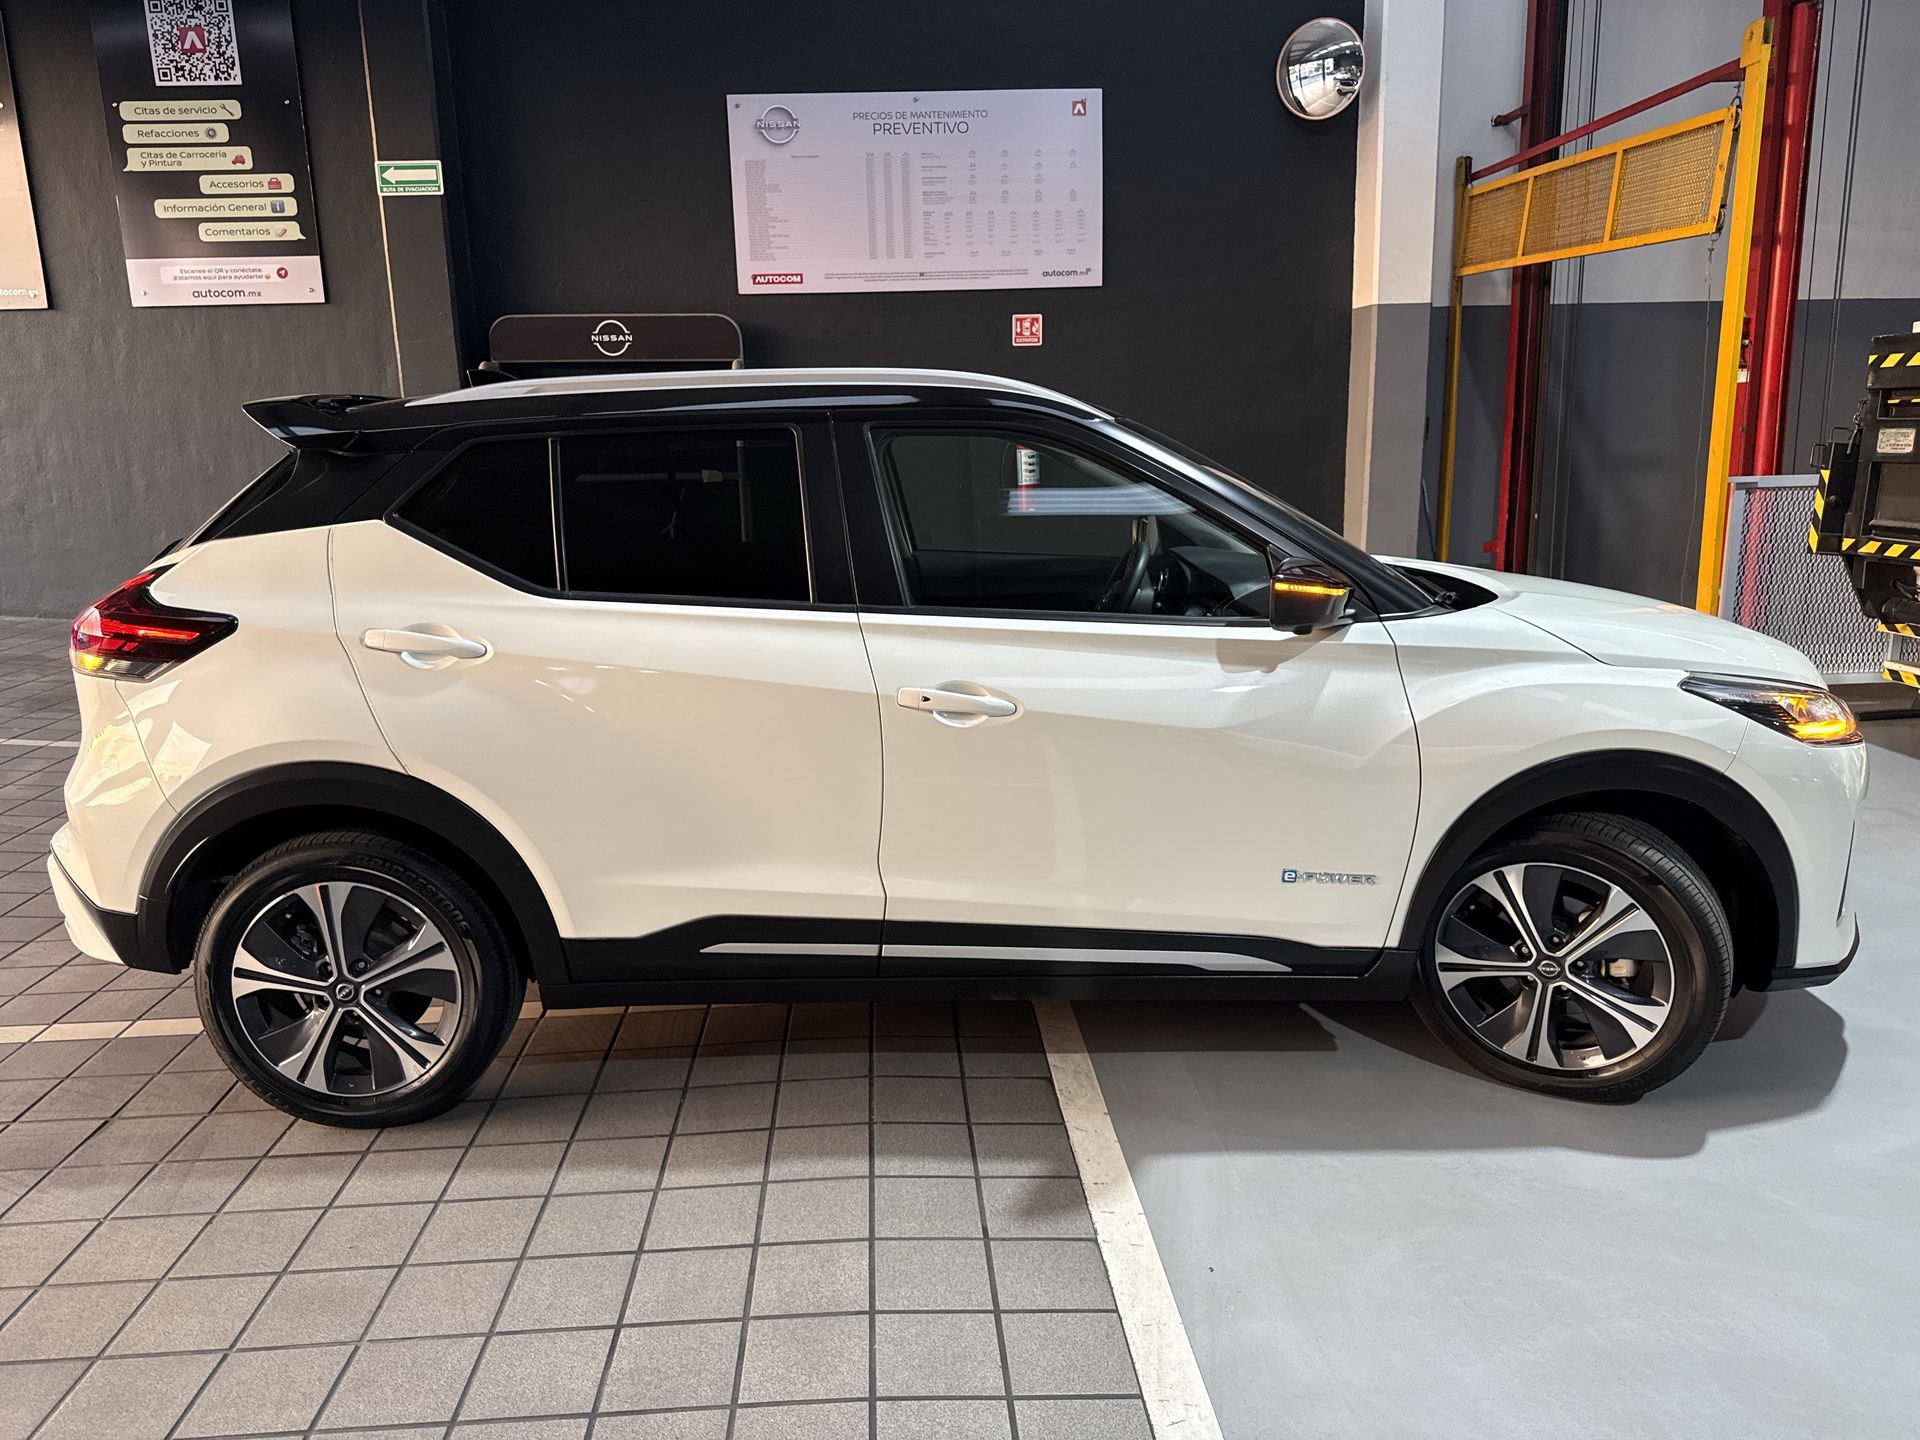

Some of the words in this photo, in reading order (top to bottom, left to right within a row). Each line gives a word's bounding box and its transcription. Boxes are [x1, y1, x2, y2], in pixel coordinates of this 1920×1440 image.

[134, 106, 161, 116] Citas
[162, 106, 176, 115] de
[178, 105, 218, 115] servicio
[853, 111, 893, 120] PRECIOS
[895, 111, 907, 120] DE
[909, 109, 989, 119] MANTENIMIENTO
[756, 120, 801, 128] NISSAN
[872, 121, 970, 135] PREVENTIVO
[137, 129, 200, 138] Refacciones
[140, 151, 164, 159] Citas
[166, 151, 178, 159] de
[140, 160, 147, 168] y
[149, 159, 182, 167] Pintura
[209, 180, 265, 189] Accesorios
[163, 203, 226, 213] Información
[228, 203, 267, 212] General
[204, 228, 271, 237] Comentarios
[755, 275, 801, 283] AUTOCOM
[192, 288, 262, 298] autocom.mx
[591, 334, 633, 342] NISSAN
